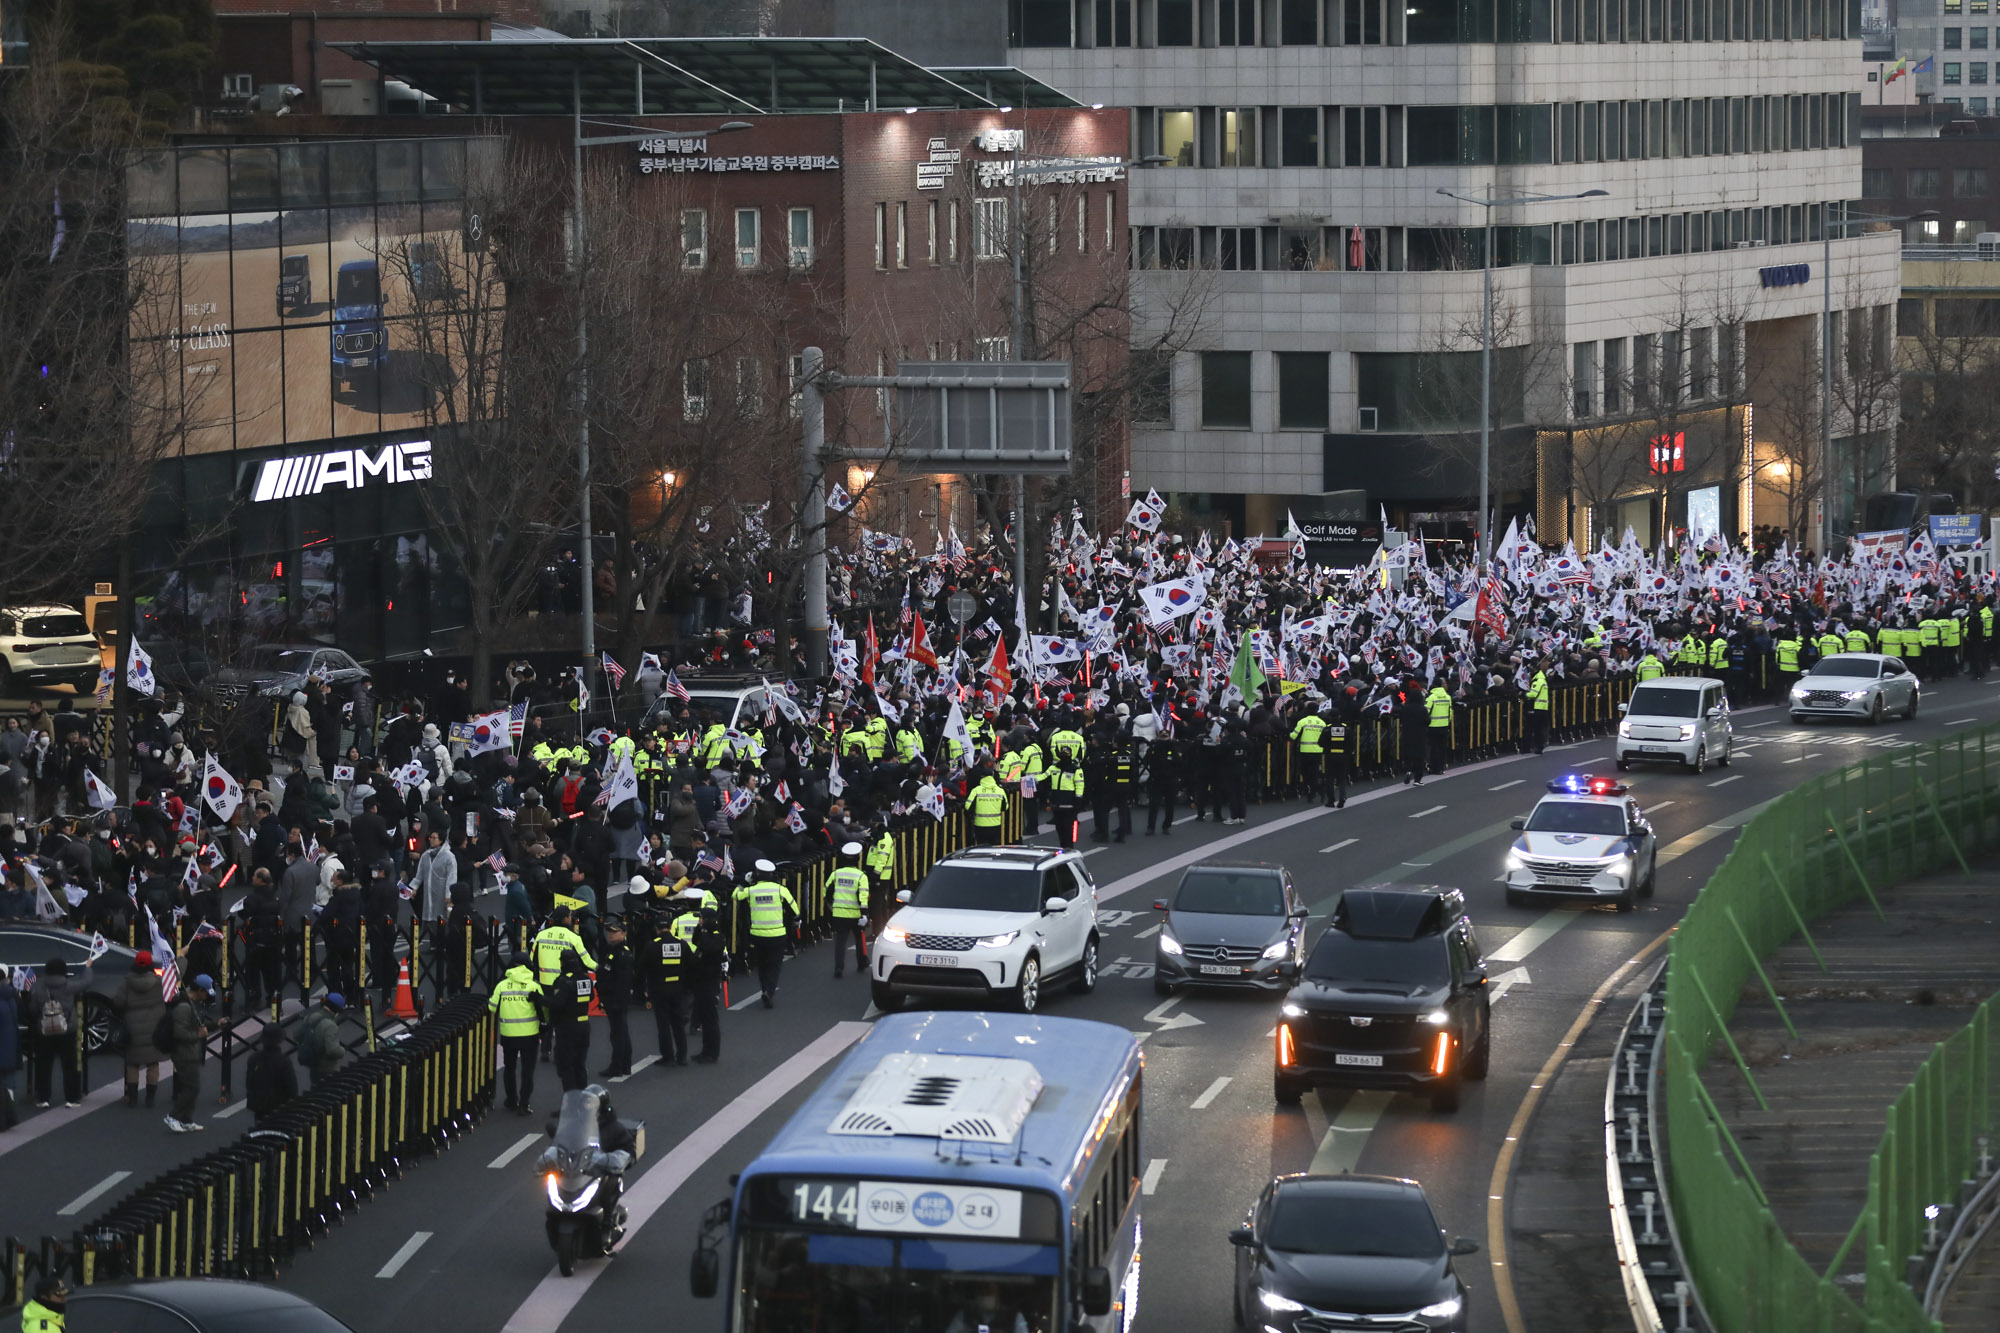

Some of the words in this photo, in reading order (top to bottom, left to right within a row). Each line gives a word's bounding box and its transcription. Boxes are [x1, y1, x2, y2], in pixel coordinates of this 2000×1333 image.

[639, 139, 707, 153] 서울특별시
[640, 157, 768, 173] 중부·남부기술교육원
[771, 155, 839, 171] 중부캠퍼스
[184, 304, 199, 316] THE
[312, 440, 433, 494] AMG
[1304, 525, 1325, 534] Golf
[1328, 526, 1357, 535] Made
[1360, 1056, 1380, 1065] 6612
[794, 1183, 857, 1222] 144
